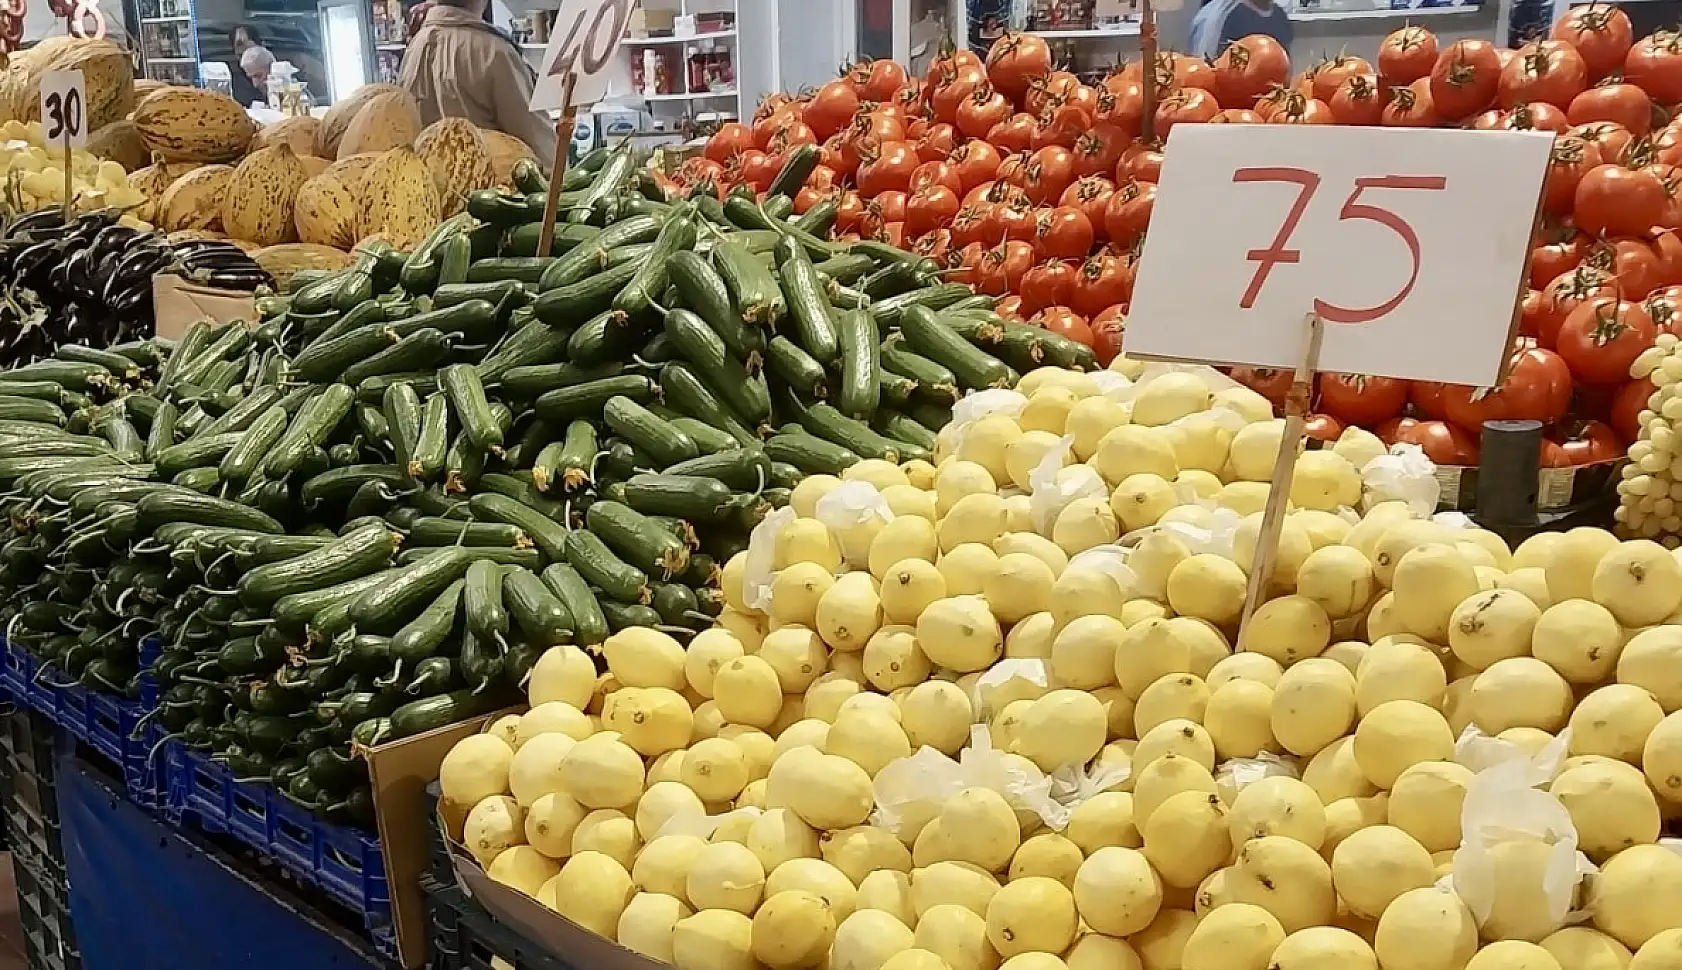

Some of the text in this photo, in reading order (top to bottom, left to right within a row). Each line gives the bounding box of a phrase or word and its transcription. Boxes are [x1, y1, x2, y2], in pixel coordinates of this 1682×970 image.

[547, 0, 628, 84] 40
[45, 87, 80, 139] 30
[1232, 167, 1447, 323] 75
